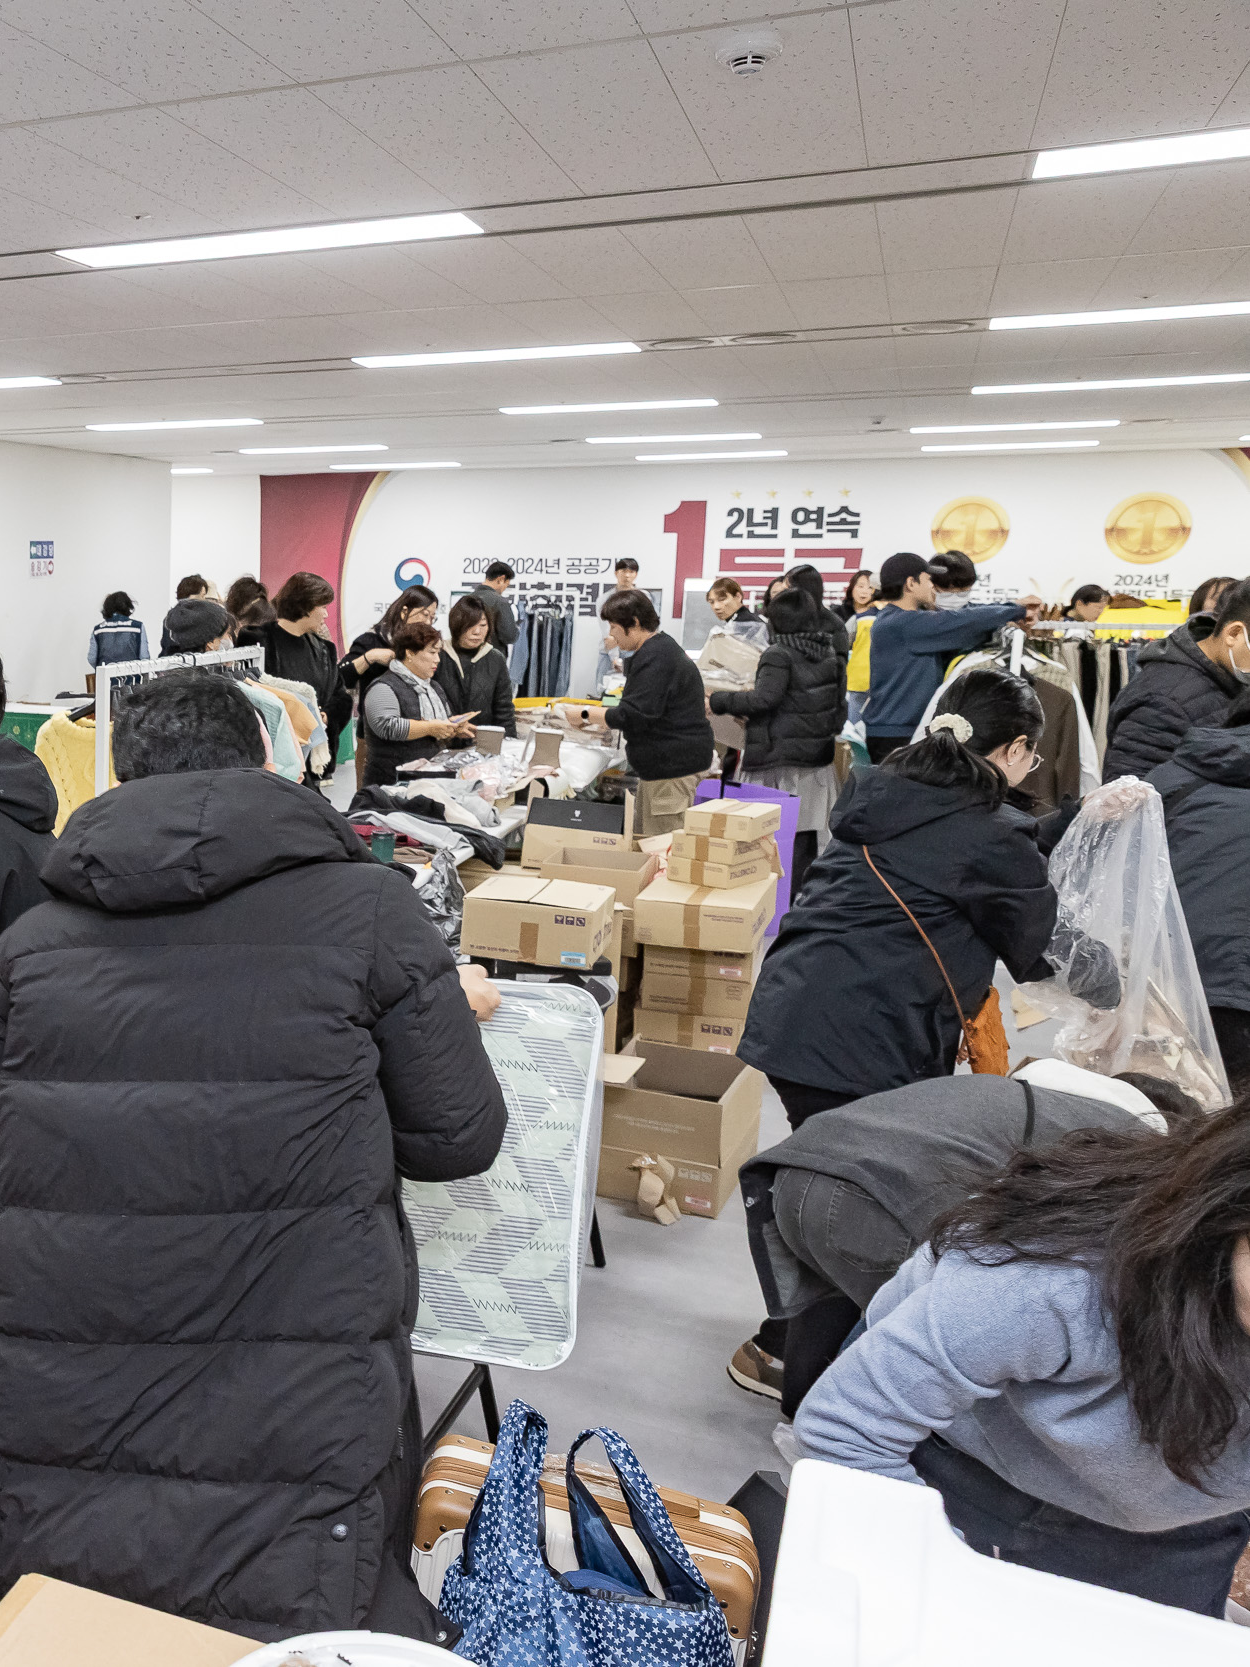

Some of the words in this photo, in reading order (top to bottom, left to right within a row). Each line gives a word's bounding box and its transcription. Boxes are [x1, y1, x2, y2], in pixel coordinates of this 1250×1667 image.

[725, 507, 780, 539] 2년
[790, 506, 861, 539] 연속
[463, 557, 499, 574] 202
[1114, 573, 1169, 588] 2024년
